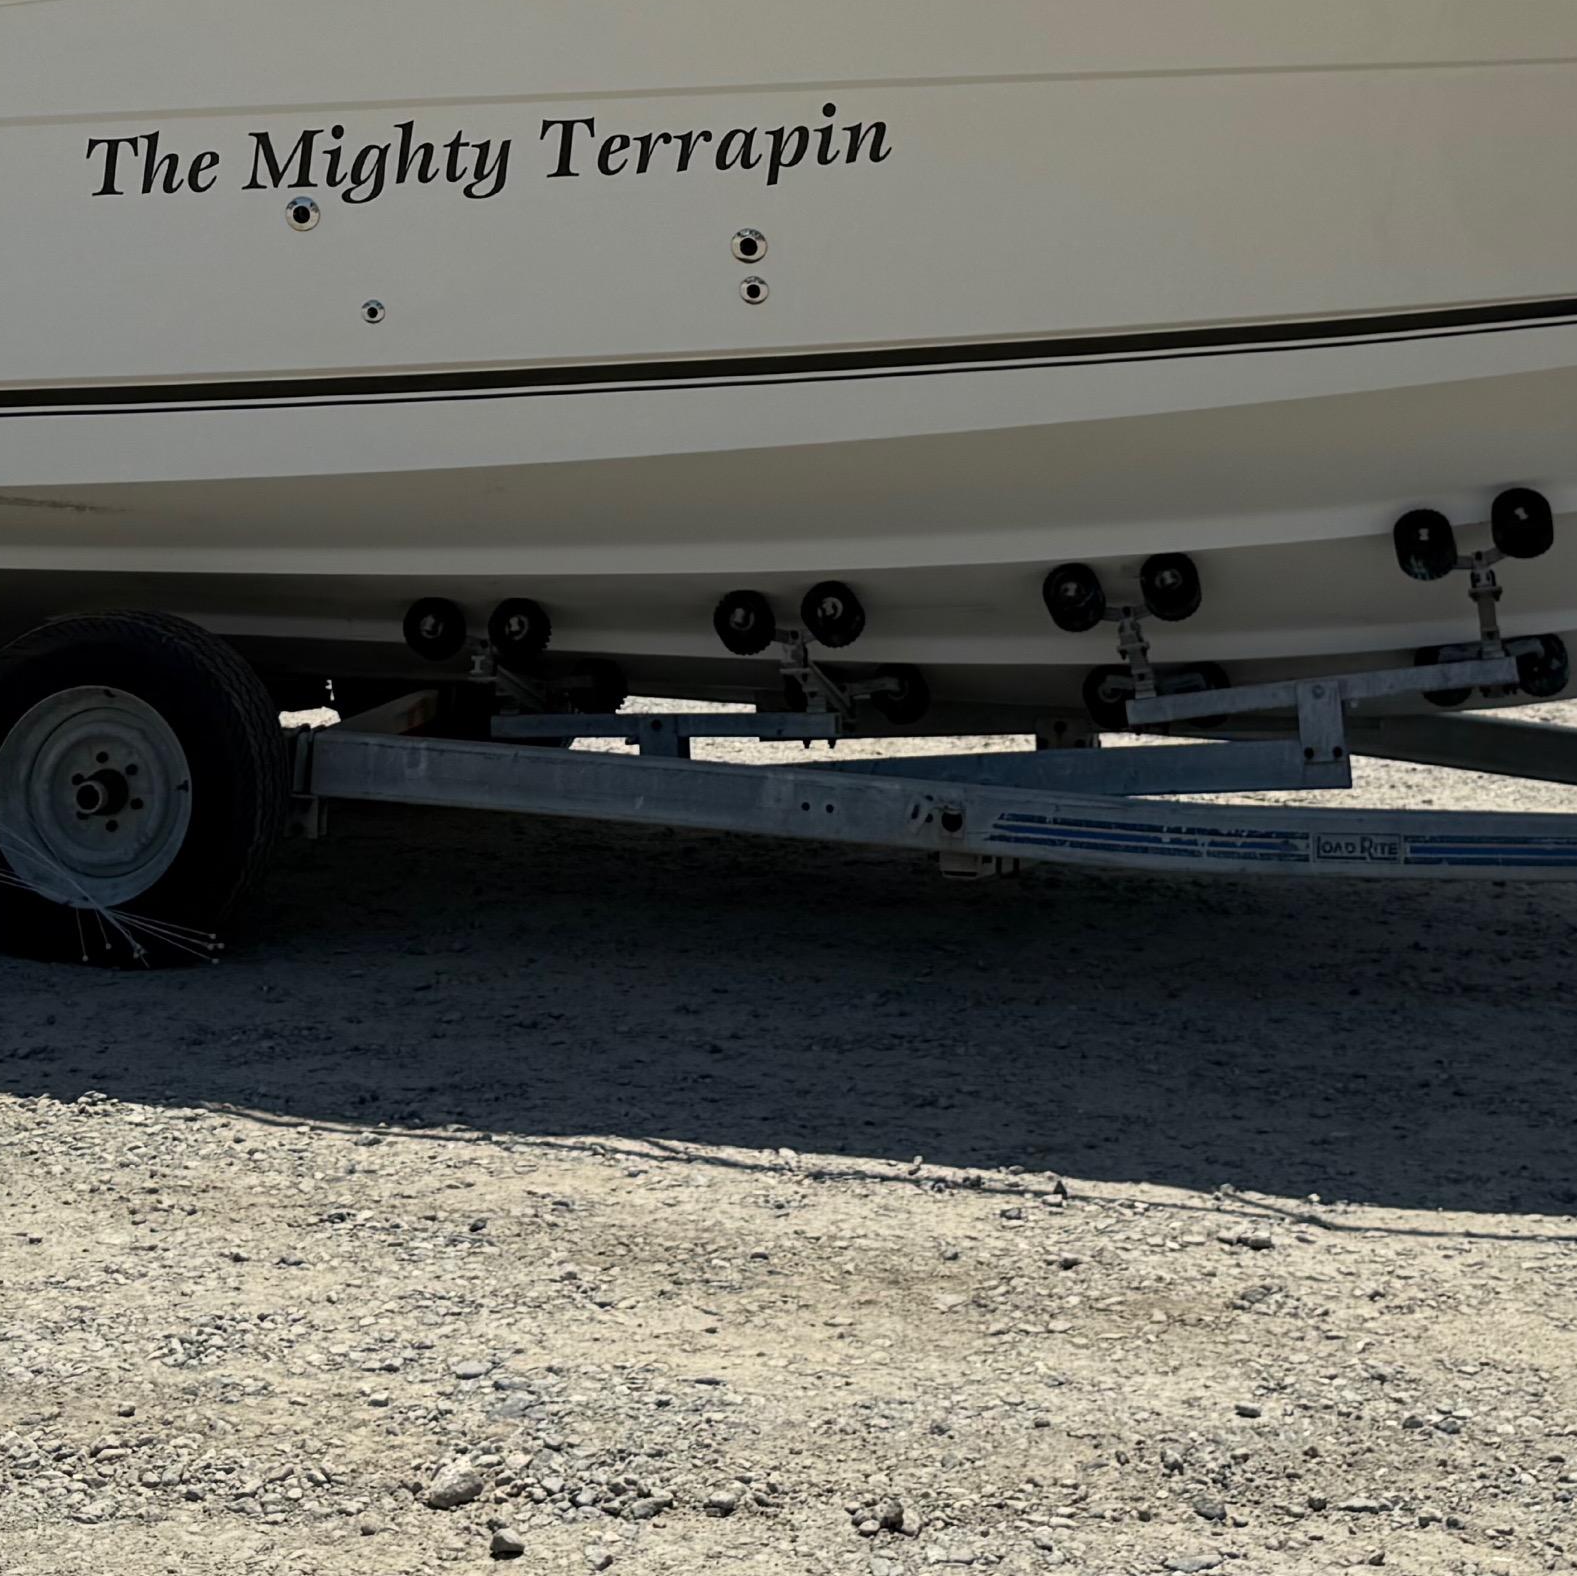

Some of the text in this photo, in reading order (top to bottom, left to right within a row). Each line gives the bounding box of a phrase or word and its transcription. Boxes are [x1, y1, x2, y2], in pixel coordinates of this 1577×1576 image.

[86, 102, 893, 204] The Mighty Terrapin
